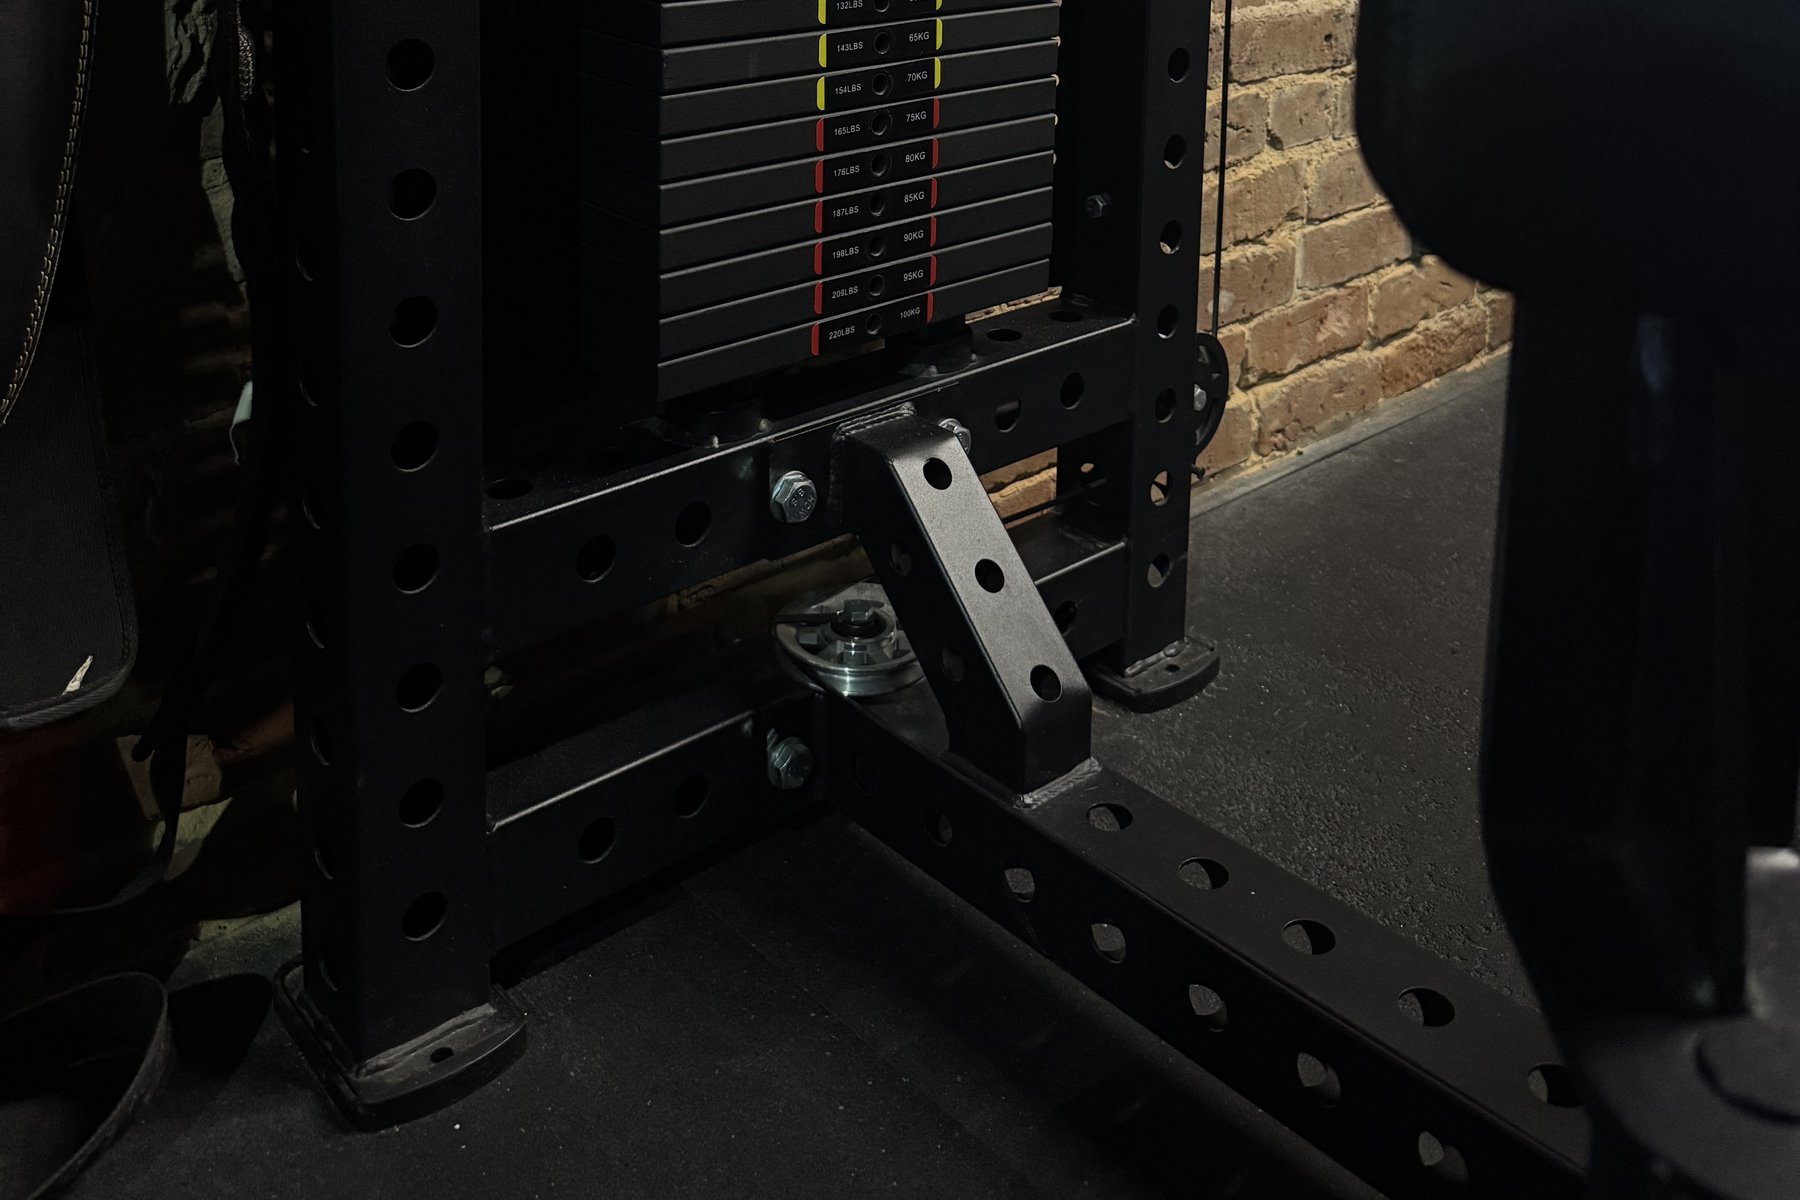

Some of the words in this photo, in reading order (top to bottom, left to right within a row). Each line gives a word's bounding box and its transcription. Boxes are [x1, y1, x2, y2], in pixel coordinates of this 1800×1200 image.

[836, 0, 864, 10] 132LBS
[908, 31, 930, 42] 65KG
[837, 41, 864, 53] 143LBS
[907, 70, 928, 82] 70KG
[835, 83, 862, 95] 154LBS
[906, 110, 927, 123] 75KG
[834, 123, 861, 136] 165LBS
[905, 151, 926, 163] 80KG
[833, 164, 860, 177] 176LBS
[903, 191, 925, 203] 85KG
[832, 205, 859, 218] 187LBS
[903, 229, 924, 242] 90KG
[832, 245, 860, 259] 198LBS
[903, 269, 924, 282] 95KG
[831, 285, 859, 299] 209LBS
[900, 306, 921, 319] 100KG
[828, 325, 856, 340] 220LBS
